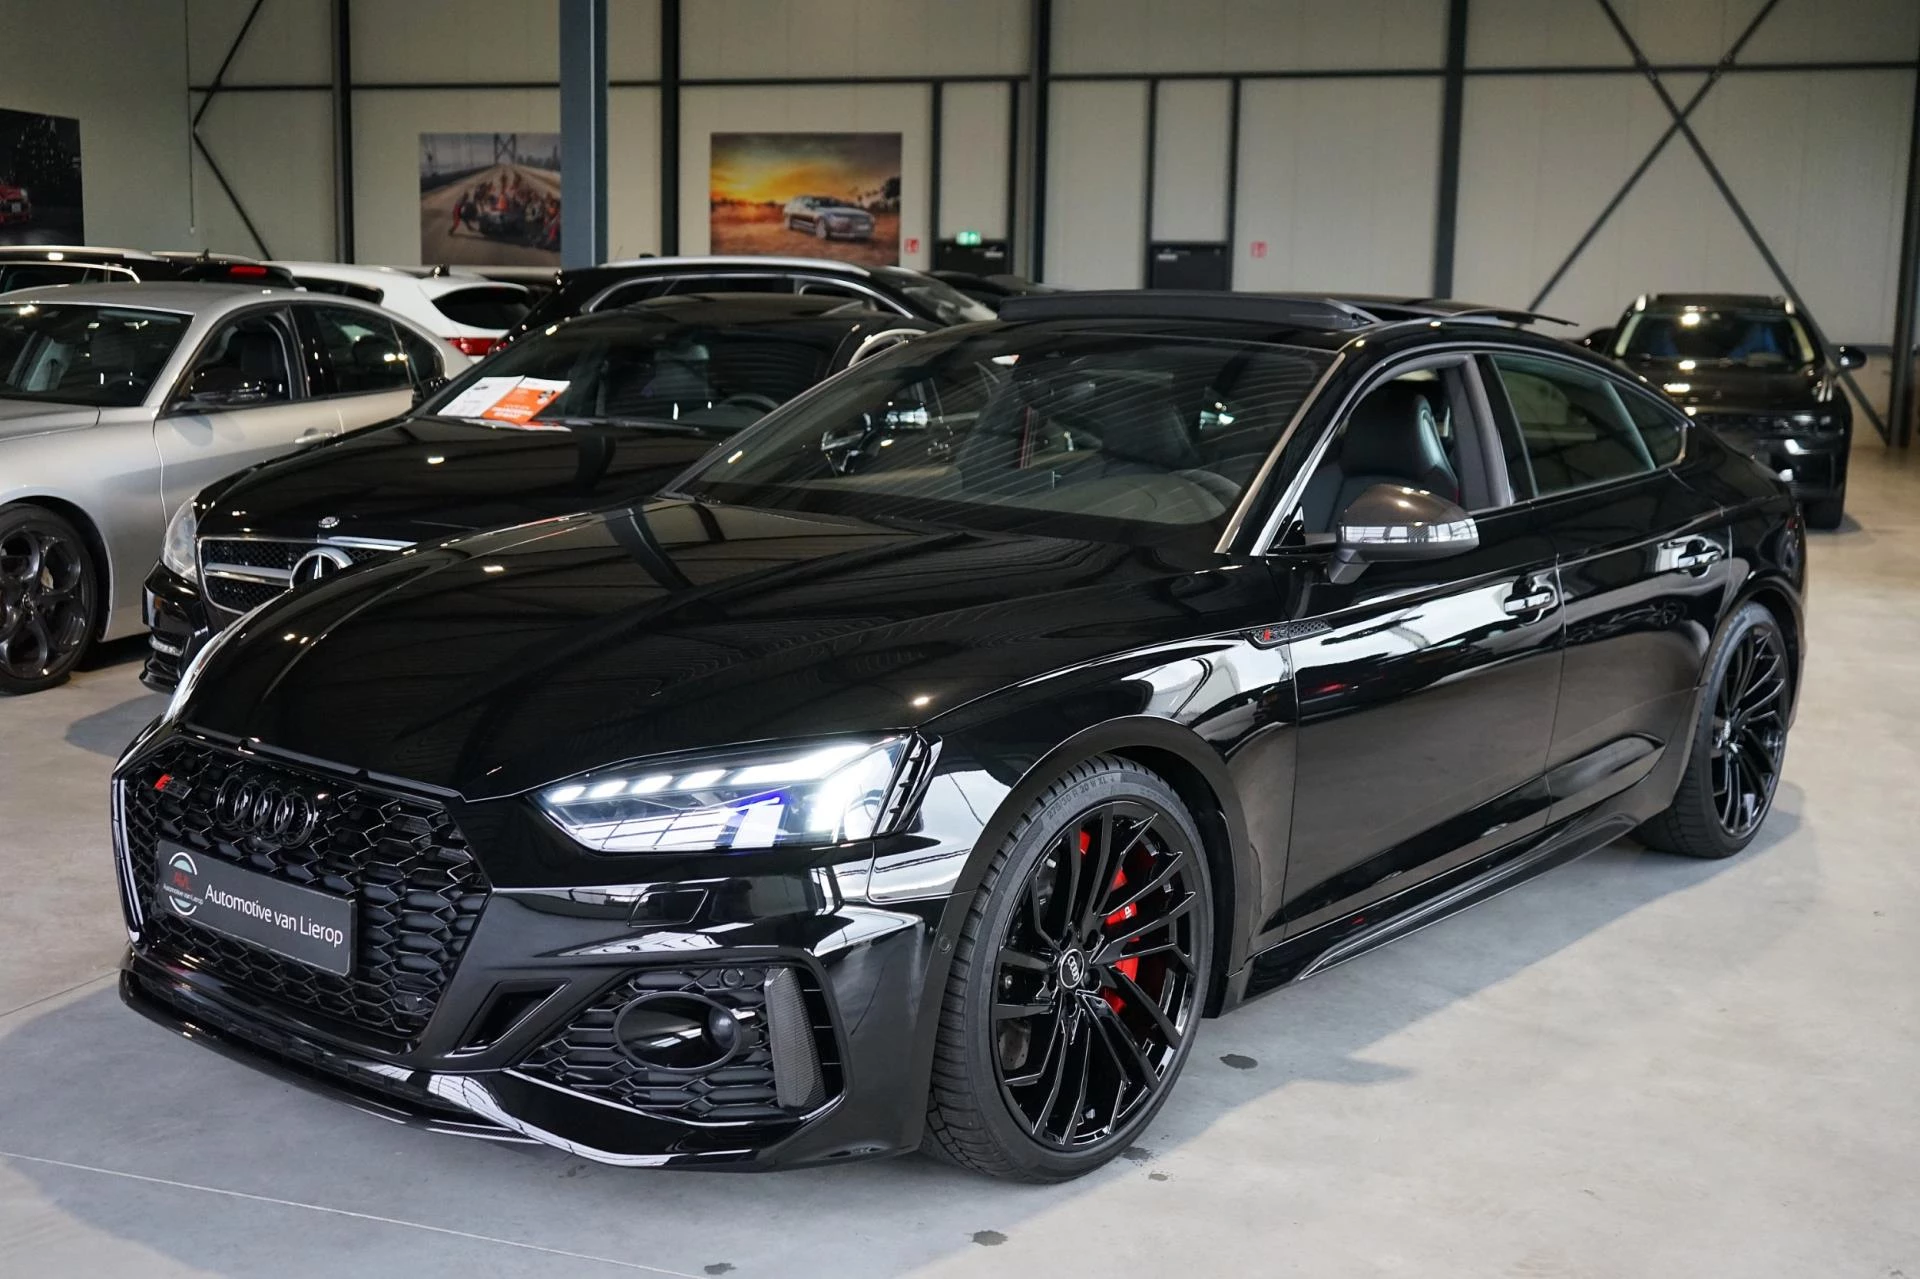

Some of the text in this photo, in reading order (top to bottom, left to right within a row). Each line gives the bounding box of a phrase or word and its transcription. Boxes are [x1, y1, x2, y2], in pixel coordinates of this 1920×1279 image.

[205, 884, 344, 948] Automotive van Lierop
